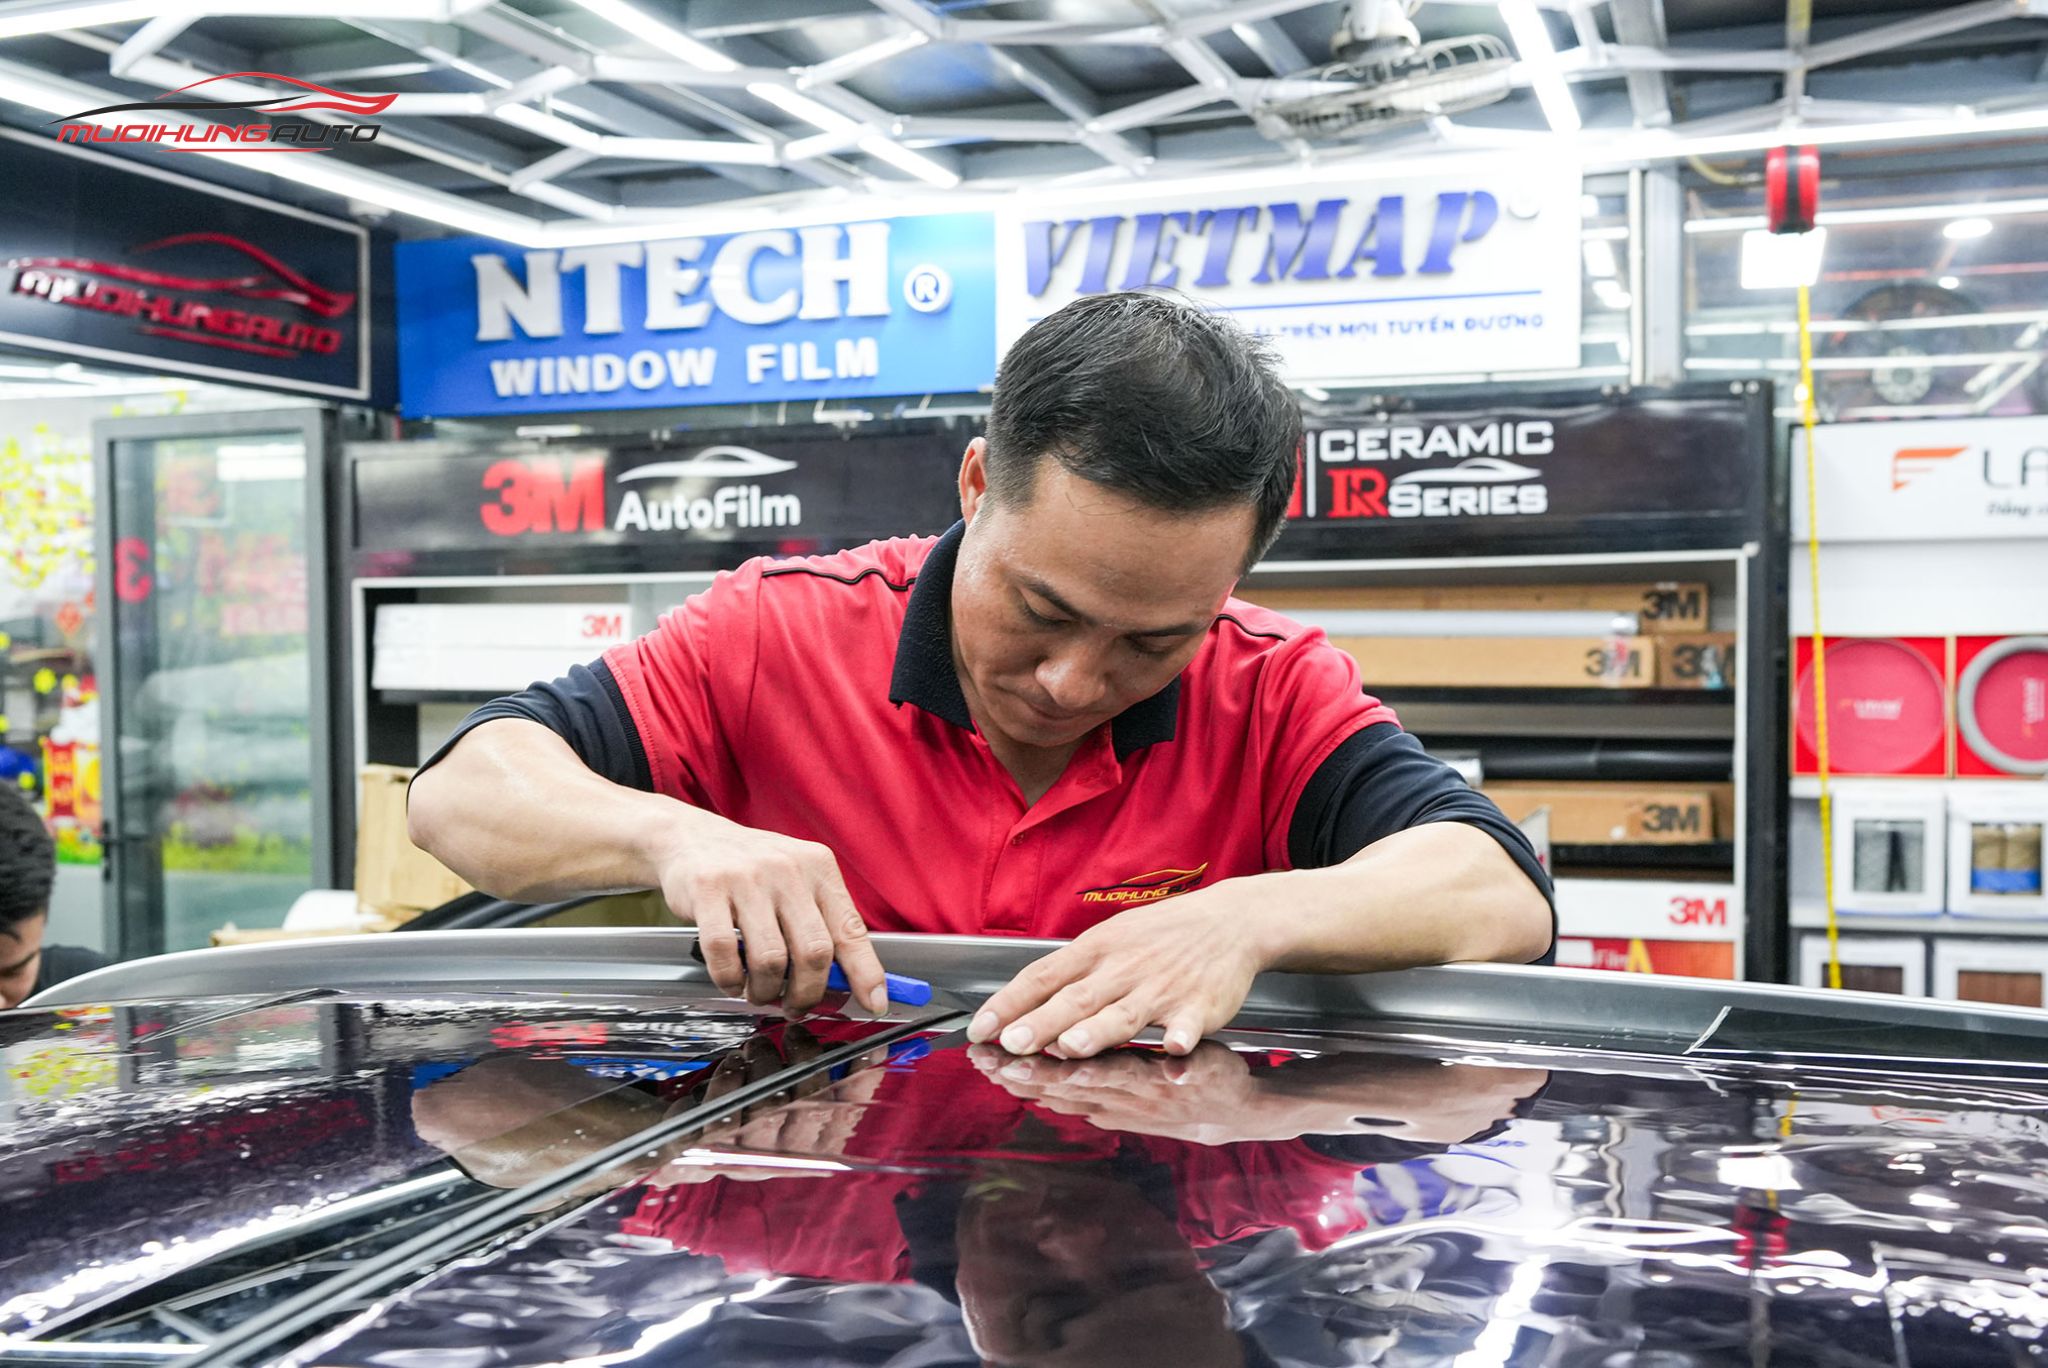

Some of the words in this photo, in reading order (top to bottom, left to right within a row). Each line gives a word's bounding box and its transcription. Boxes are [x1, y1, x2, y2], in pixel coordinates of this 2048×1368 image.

[1023, 190, 1499, 298] VIETMAP
[471, 221, 891, 341] NTECH
[490, 347, 717, 398] WINDOW
[746, 336, 881, 384] FILM
[1319, 420, 1554, 462] CERAMIC
[480, 458, 606, 537] 3M
[613, 484, 801, 532] AutoFilm
[580, 613, 622, 638] 3M
[1642, 590, 1700, 620] 3M
[1642, 803, 1701, 833] 3M
[1668, 896, 1728, 927] 3M
